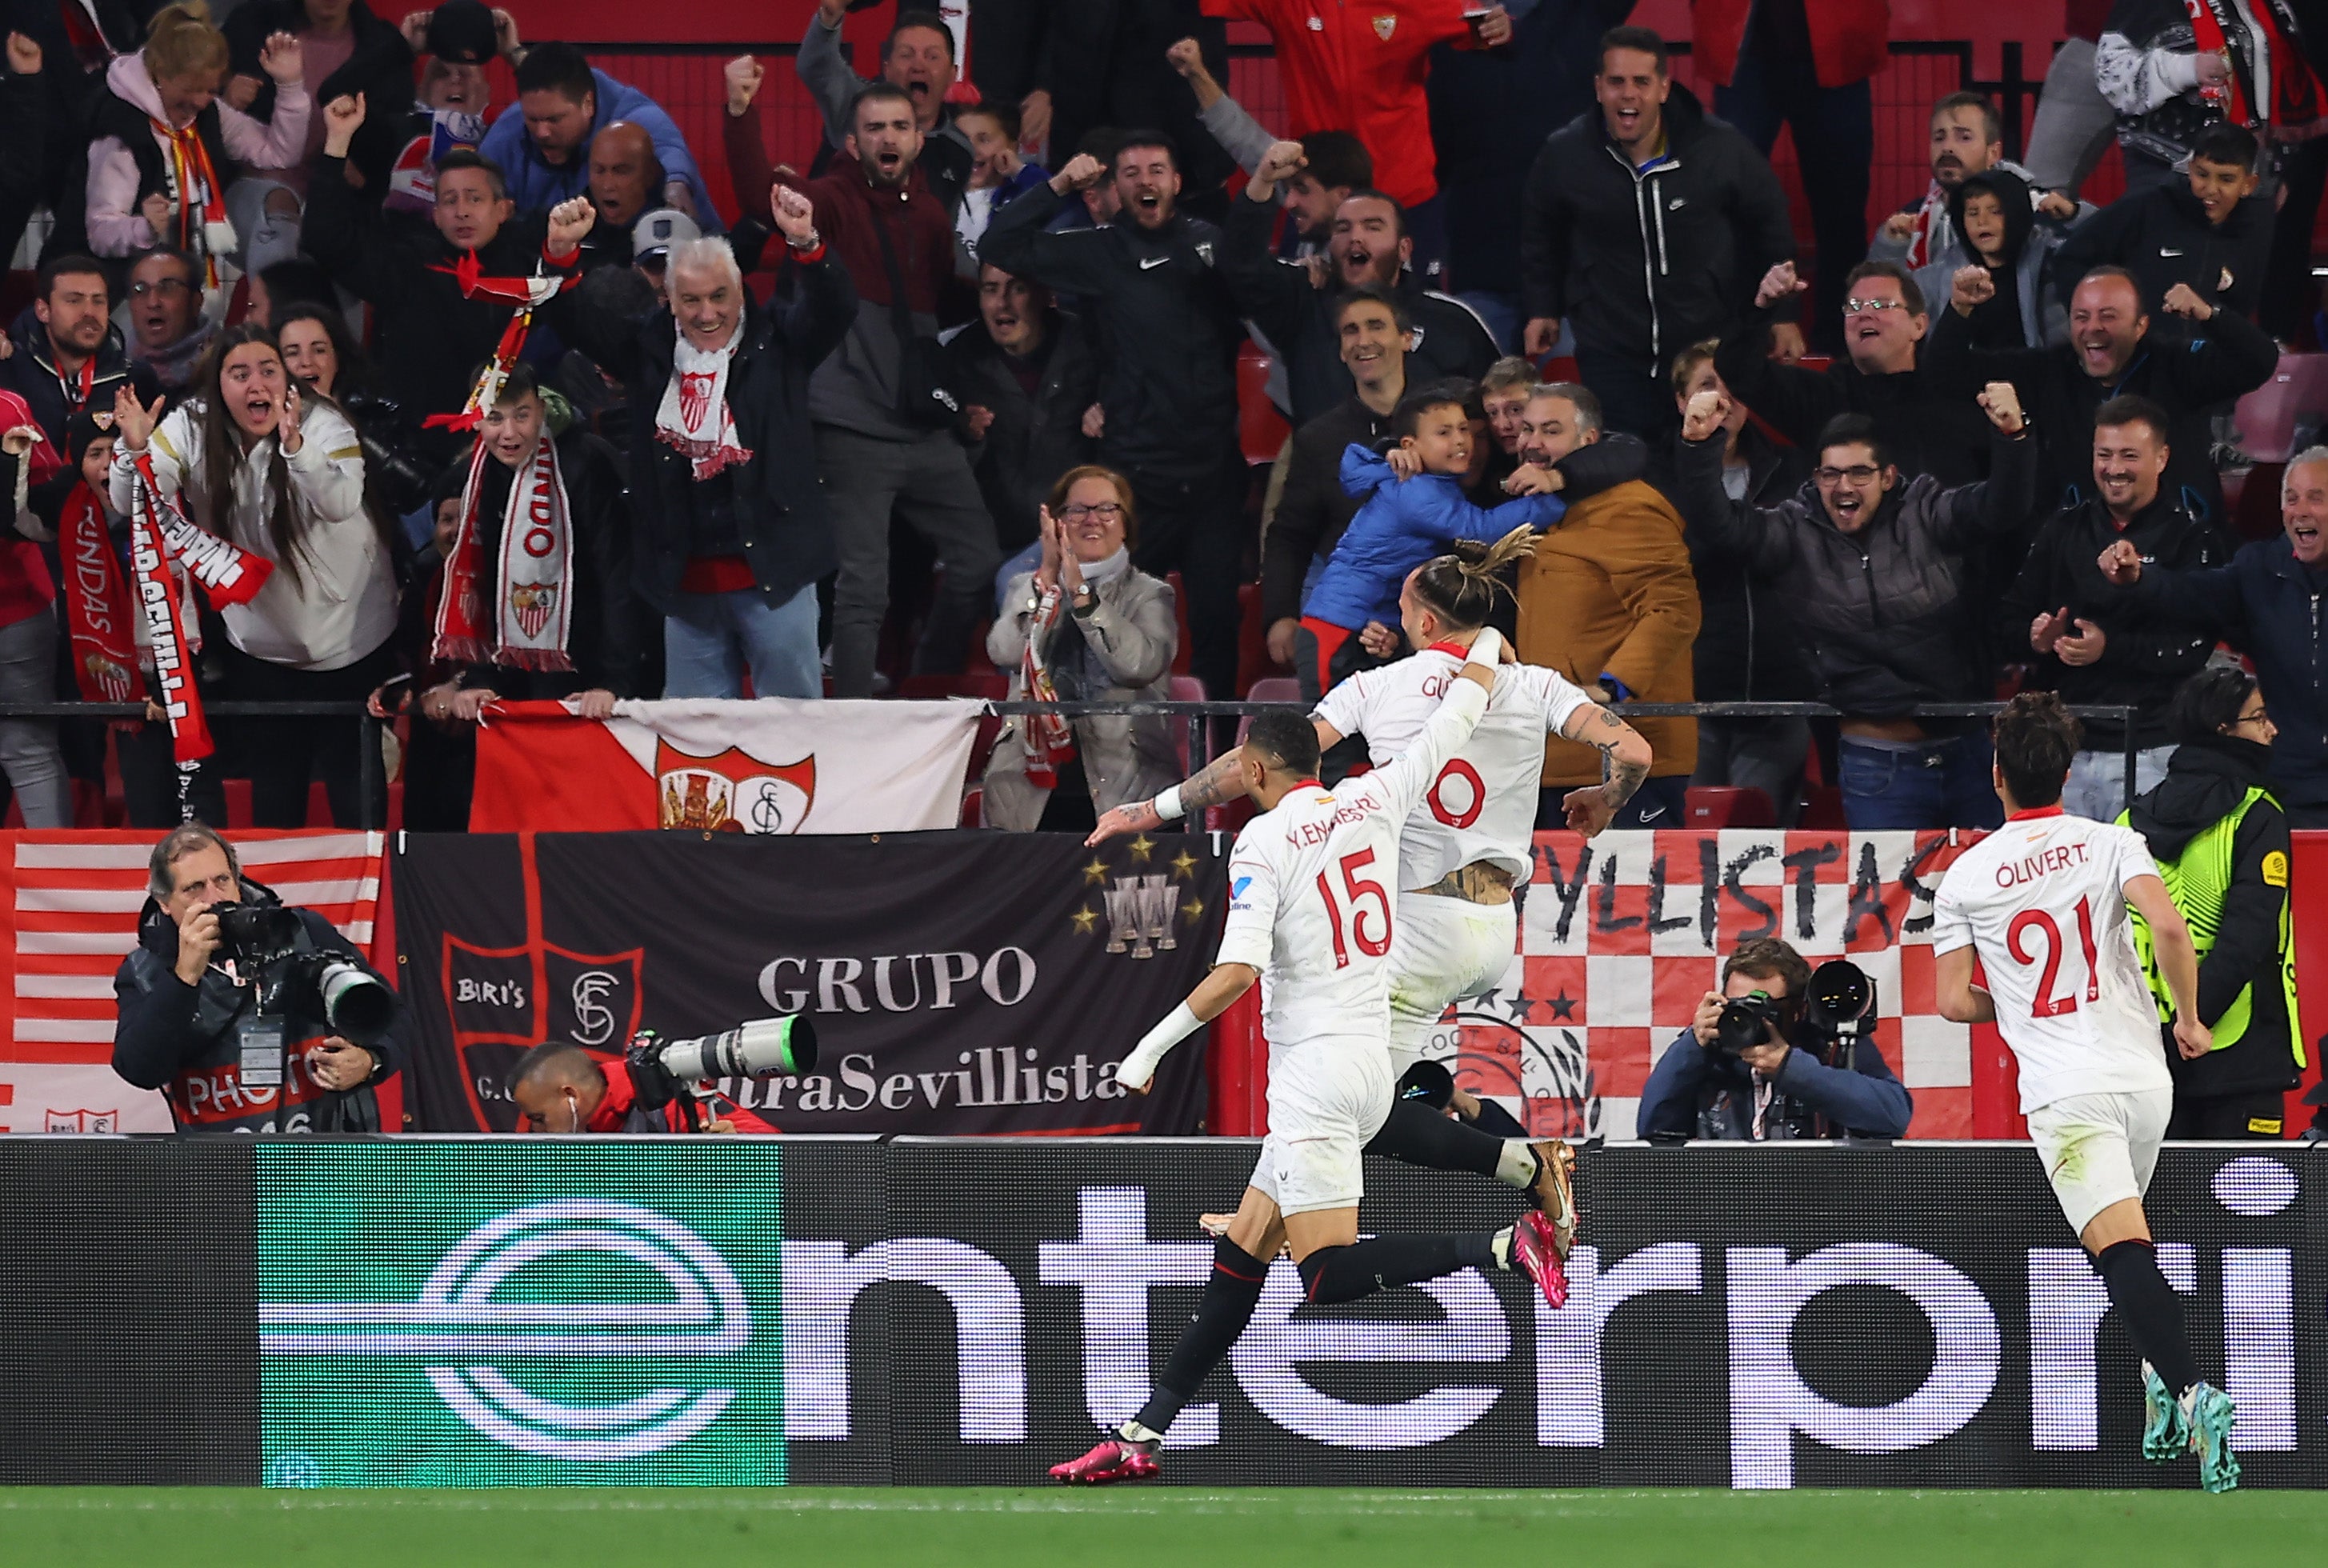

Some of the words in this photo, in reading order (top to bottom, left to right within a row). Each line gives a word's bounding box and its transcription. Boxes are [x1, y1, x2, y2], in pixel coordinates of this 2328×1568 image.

[1316, 844, 1393, 970] 15
[758, 946, 1038, 1014] GRUPO
[2006, 893, 2100, 1018] 21
[717, 1046, 1128, 1112] traSevillista
